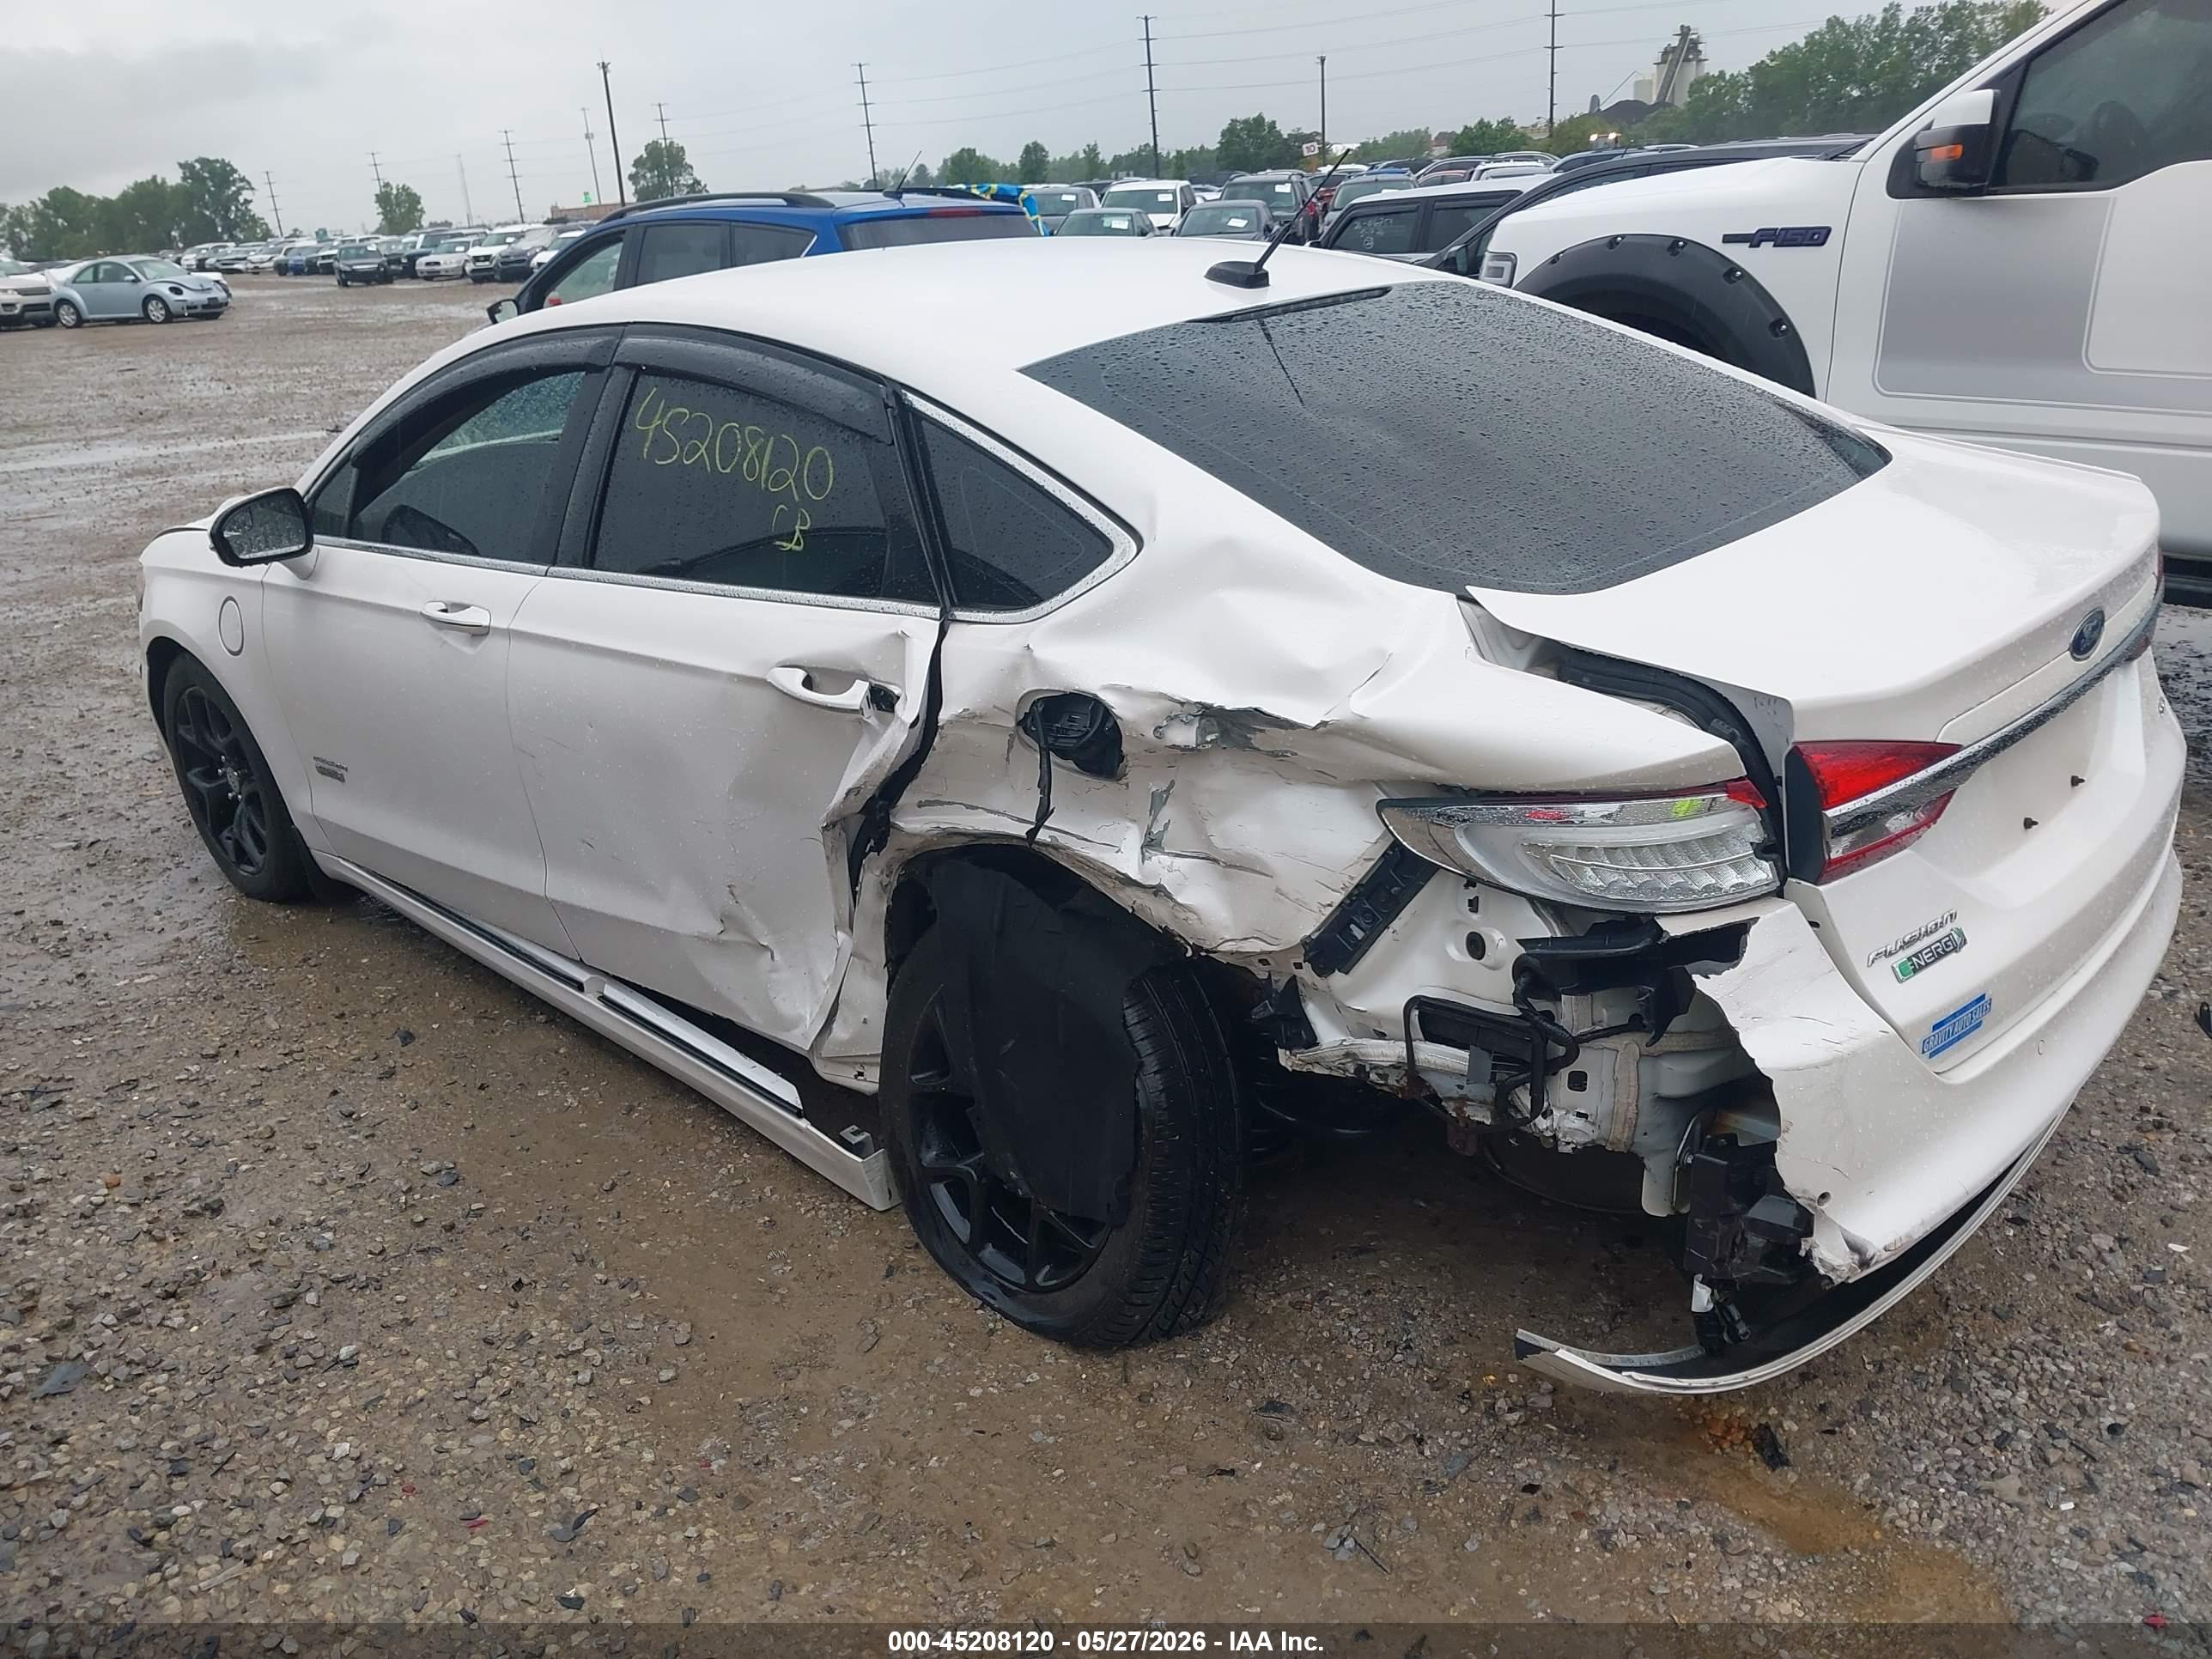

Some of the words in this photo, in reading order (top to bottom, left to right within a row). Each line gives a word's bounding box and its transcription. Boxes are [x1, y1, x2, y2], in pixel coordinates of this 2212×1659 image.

[635, 387, 834, 501] 45208120
[1867, 908, 1958, 968] FUSION
[1893, 933, 1959, 981] ENERGI
[1923, 1023, 1955, 1053] GRAVITY
[1953, 1012, 1972, 1036] AUTO
[1971, 1000, 1991, 1024] SALES
